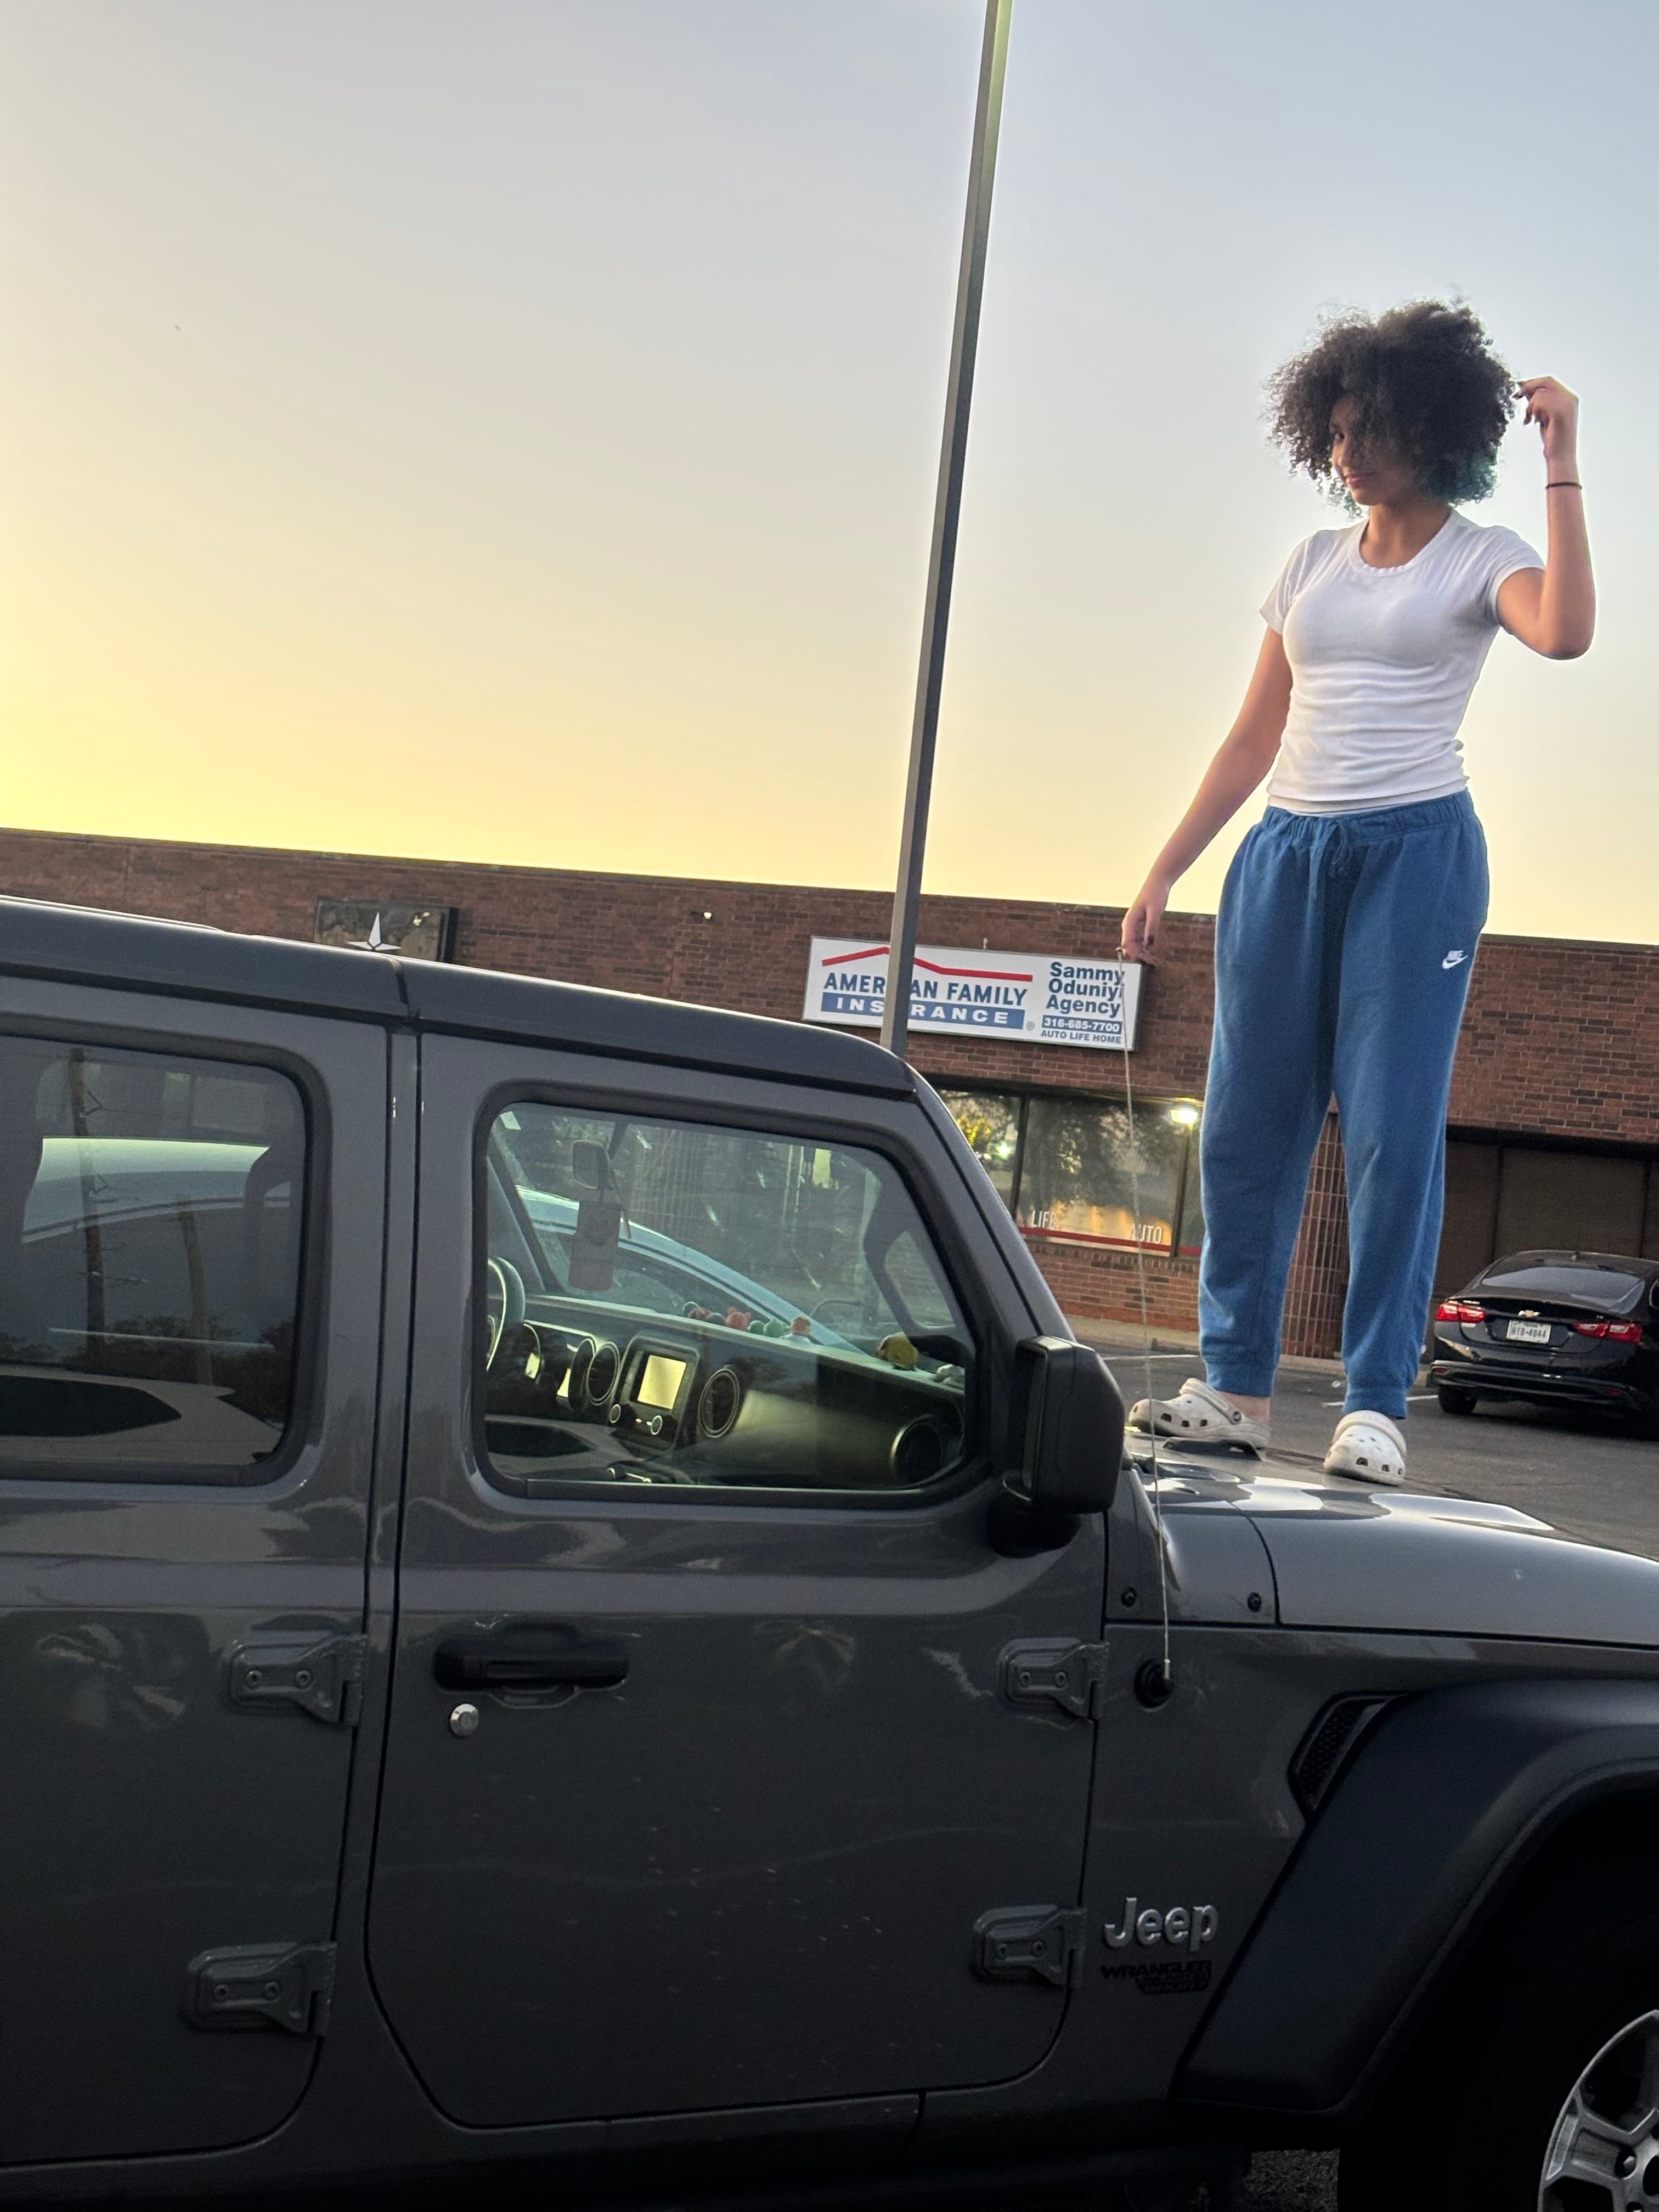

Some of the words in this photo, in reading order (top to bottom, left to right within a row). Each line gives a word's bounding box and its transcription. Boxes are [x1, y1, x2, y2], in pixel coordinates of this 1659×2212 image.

[1050, 962, 1125, 985] Sammy
[824, 972, 938, 998] AMERAN
[947, 983, 1028, 1006] FAMILY
[837, 997, 1008, 1024] INSRANCE
[1046, 995, 1121, 1018] Agency
[1041, 1029, 1067, 1039] AUTO
[1070, 1032, 1090, 1041] LIFE
[1093, 1034, 1121, 1043] HOME
[1044, 1018, 1120, 1032] 316-685-7700
[1130, 1223, 1162, 1244] AUTO
[1103, 1897, 1218, 1951] Jeep
